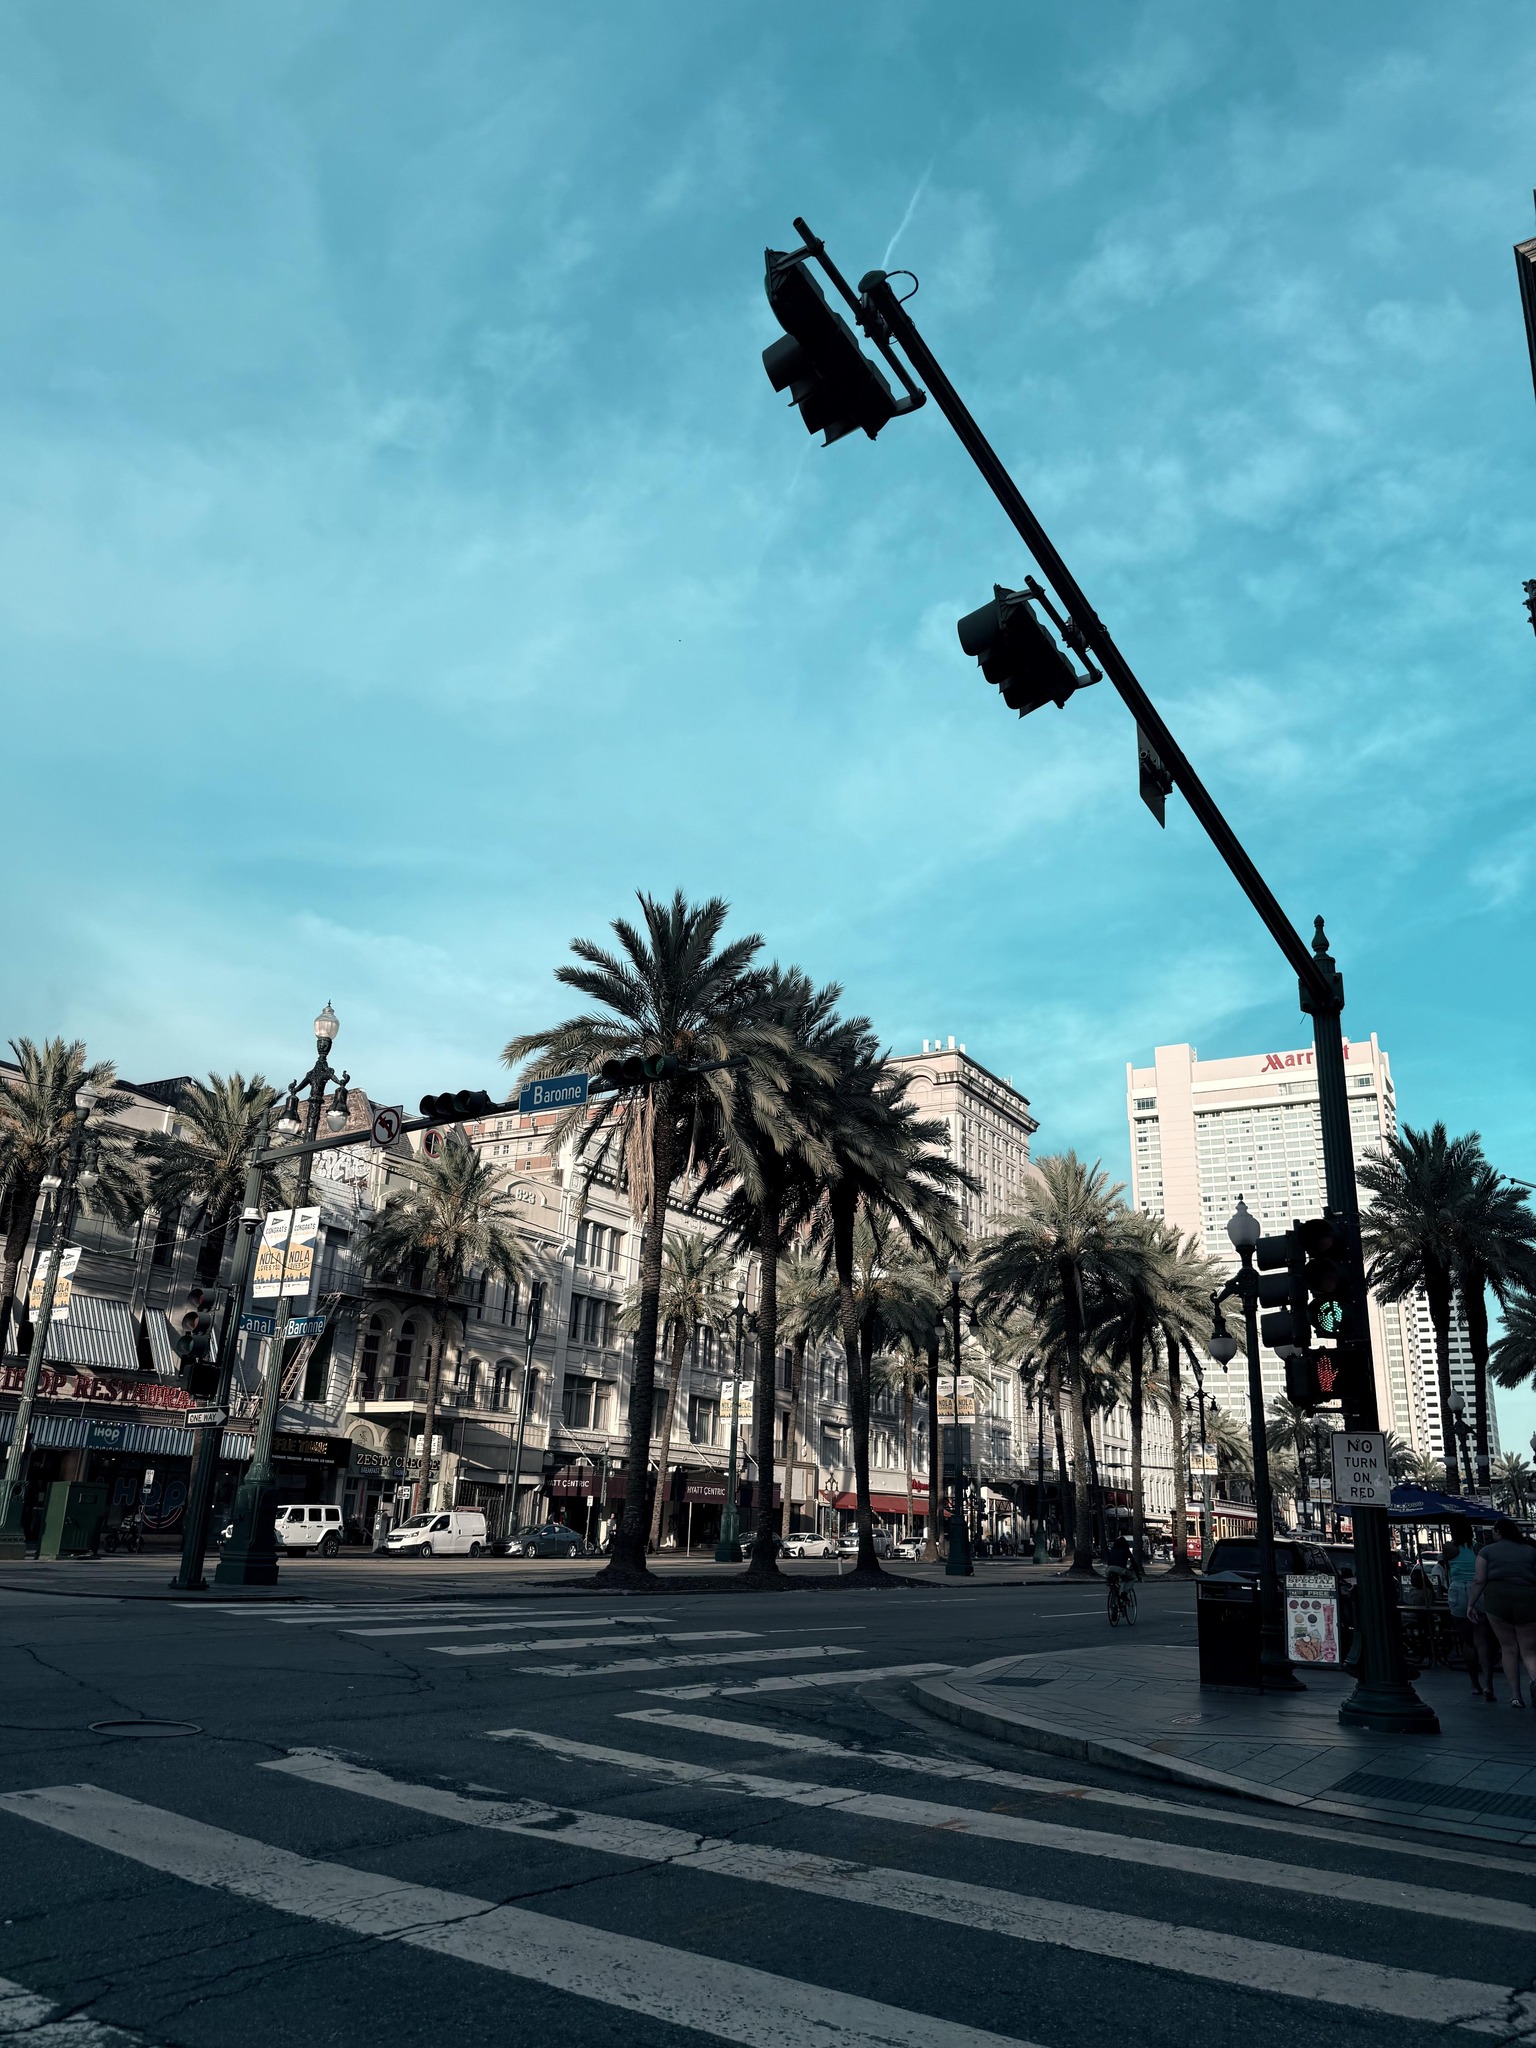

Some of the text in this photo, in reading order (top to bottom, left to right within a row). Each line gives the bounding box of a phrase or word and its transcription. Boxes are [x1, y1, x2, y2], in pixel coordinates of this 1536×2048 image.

[1261, 1044, 1349, 1073] Marrt
[534, 1085, 582, 1105] Baronne
[516, 1188, 535, 1204] 823
[266, 1226, 287, 1234] CONGRATS
[294, 1223, 316, 1231] CONGRATS
[260, 1253, 281, 1265] NOLA
[289, 1250, 310, 1263] NOLA
[288, 1320, 323, 1335] Baronne
[72, 1375, 196, 1409] RESTAURA
[190, 1413, 217, 1422] ONE WAY
[1348, 1440, 1372, 1453] NO
[357, 1454, 393, 1467] ZESTY
[1344, 1457, 1377, 1468] TURN
[562, 1480, 590, 1488] CENTRIC
[1354, 1472, 1370, 1484] ON
[687, 1486, 725, 1495] HYATT CENTRIC
[1351, 1487, 1375, 1498] RED
